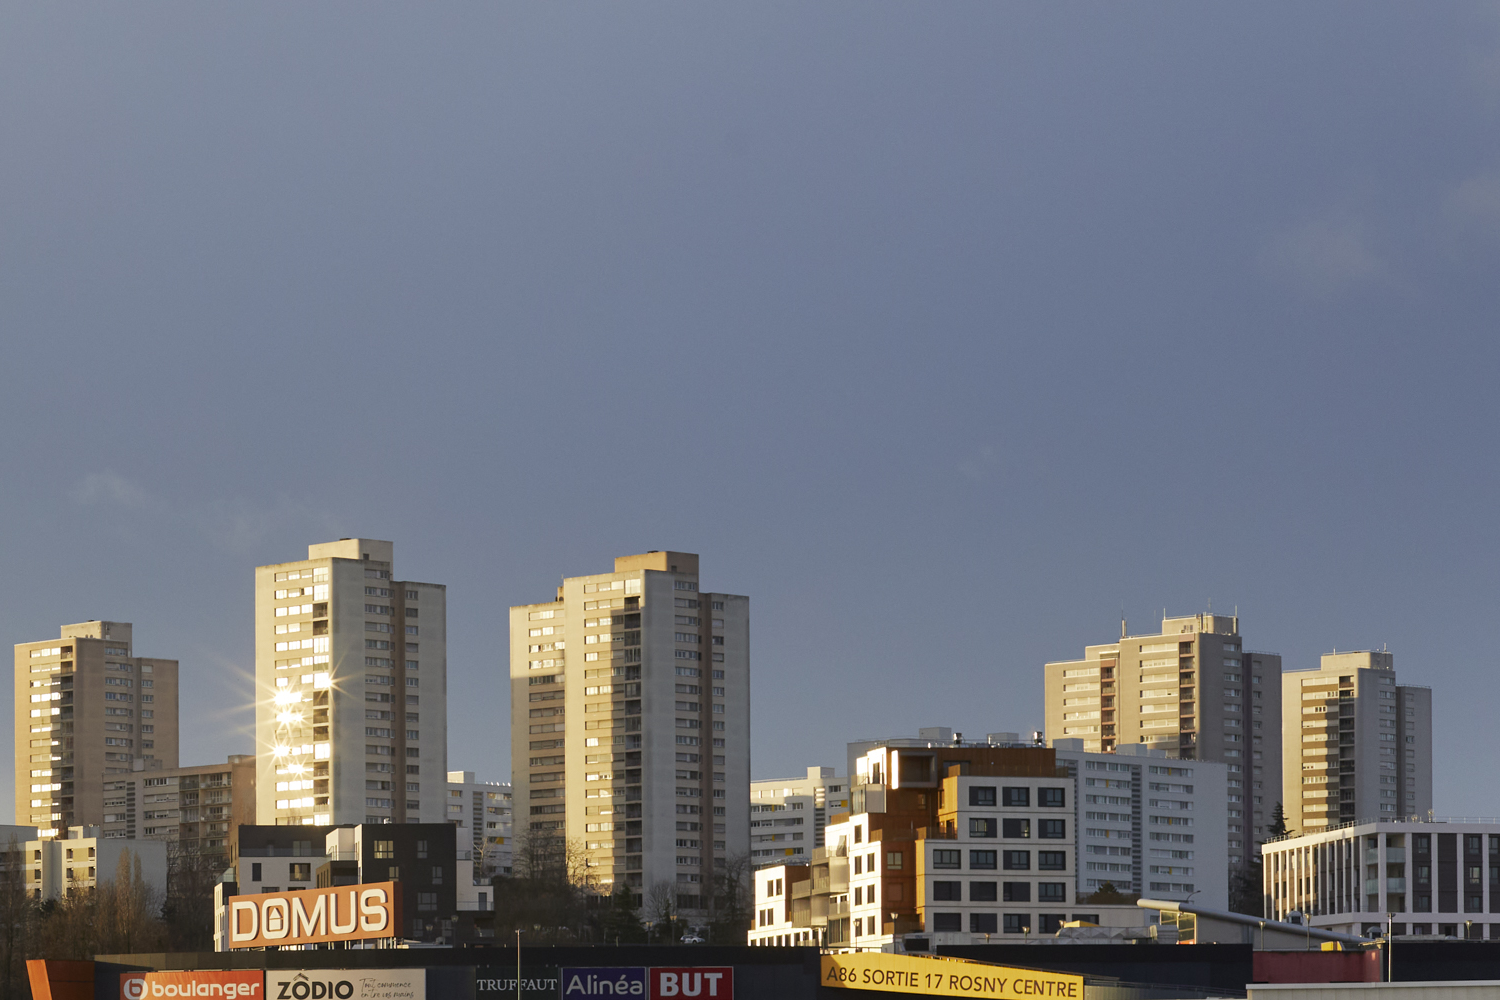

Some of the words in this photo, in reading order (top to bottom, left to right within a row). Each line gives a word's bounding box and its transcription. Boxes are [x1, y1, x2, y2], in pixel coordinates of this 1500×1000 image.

[232, 888, 388, 942] DOMUS
[151, 980, 260, 1000] boulanger
[276, 972, 354, 1000] ZÔDIO
[359, 977, 376, 993] Tout
[476, 978, 558, 992] TRUFFAUT
[565, 974, 644, 995] Alinéa
[659, 972, 723, 997] BUT
[826, 966, 857, 983] A86
[862, 968, 919, 988] SORTIE
[925, 973, 943, 989] 17
[949, 975, 1008, 993] ROSNY
[1013, 978, 1078, 998] CENTRE
